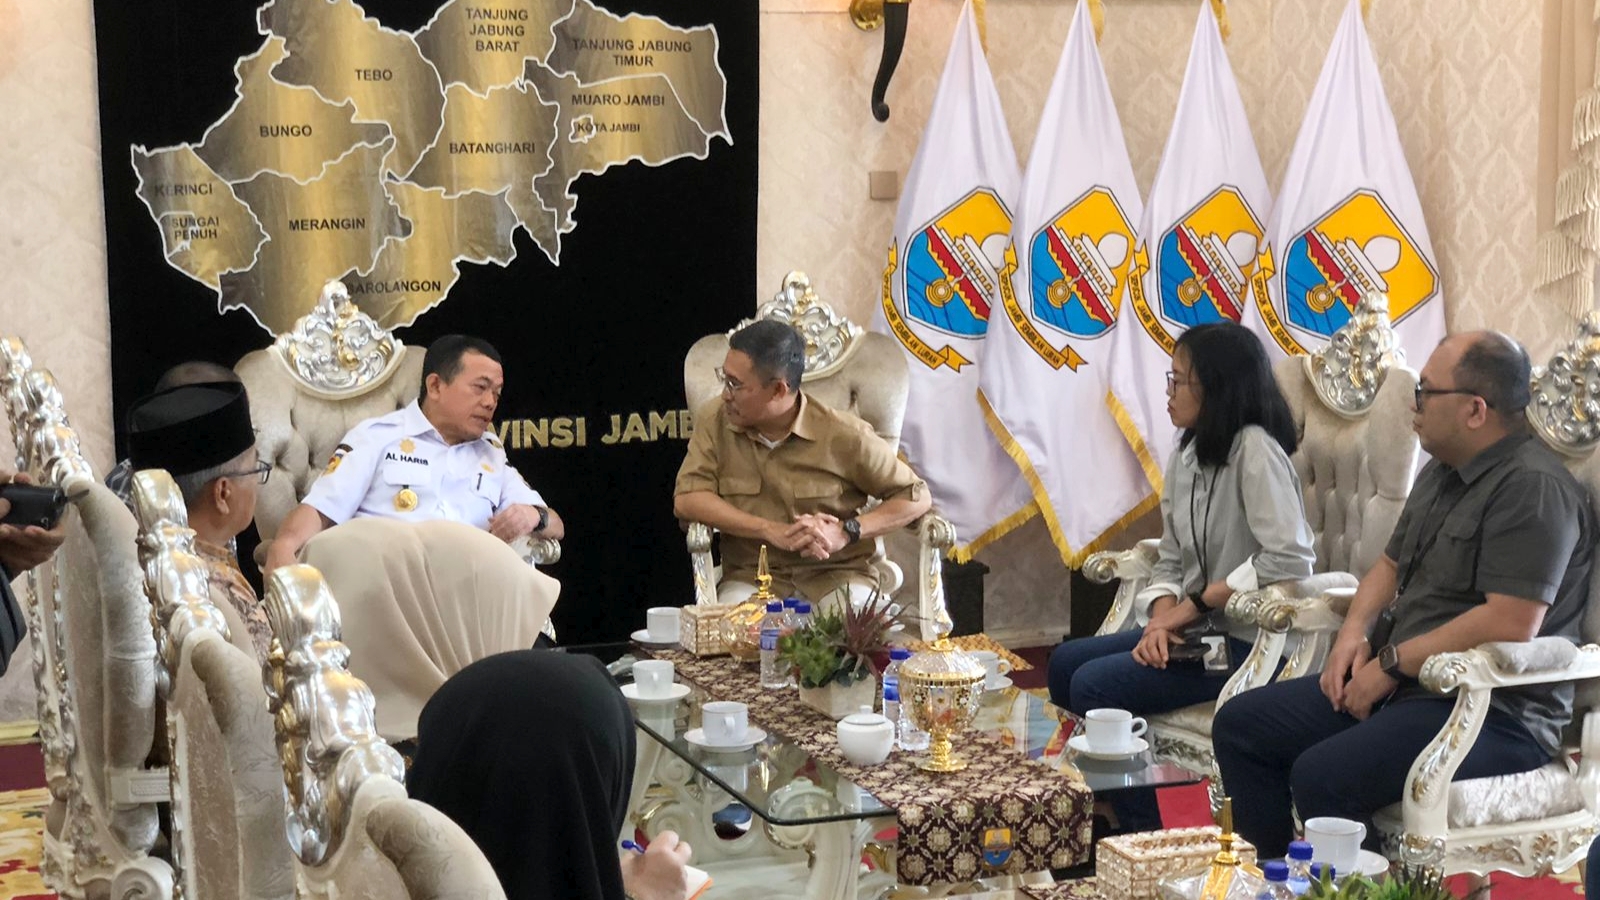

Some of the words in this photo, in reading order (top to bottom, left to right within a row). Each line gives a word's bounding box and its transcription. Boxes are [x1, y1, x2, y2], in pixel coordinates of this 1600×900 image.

[465, 8, 529, 22] TANJUNG
[469, 24, 525, 37] JABUNG
[475, 40, 520, 52] BARAT
[572, 38, 635, 52] TANJUNG
[638, 40, 692, 53] JABUNG
[613, 55, 654, 67] TIMUR
[355, 69, 393, 81] TEBO
[571, 94, 621, 106] MUARO
[623, 94, 665, 106] JAMBI
[259, 125, 313, 138] BUNGO
[577, 123, 608, 133] KOTA
[609, 123, 641, 133] JAMBI
[449, 142, 536, 155] BATANGHARI
[154, 183, 213, 197] KERINCI
[171, 216, 220, 228] SUNGAI
[288, 218, 366, 231] MERANGIN
[173, 229, 218, 241] PENUH
[488, 417, 586, 449] VINSI
[600, 410, 694, 445] JAMB
[385, 452, 398, 461] AL
